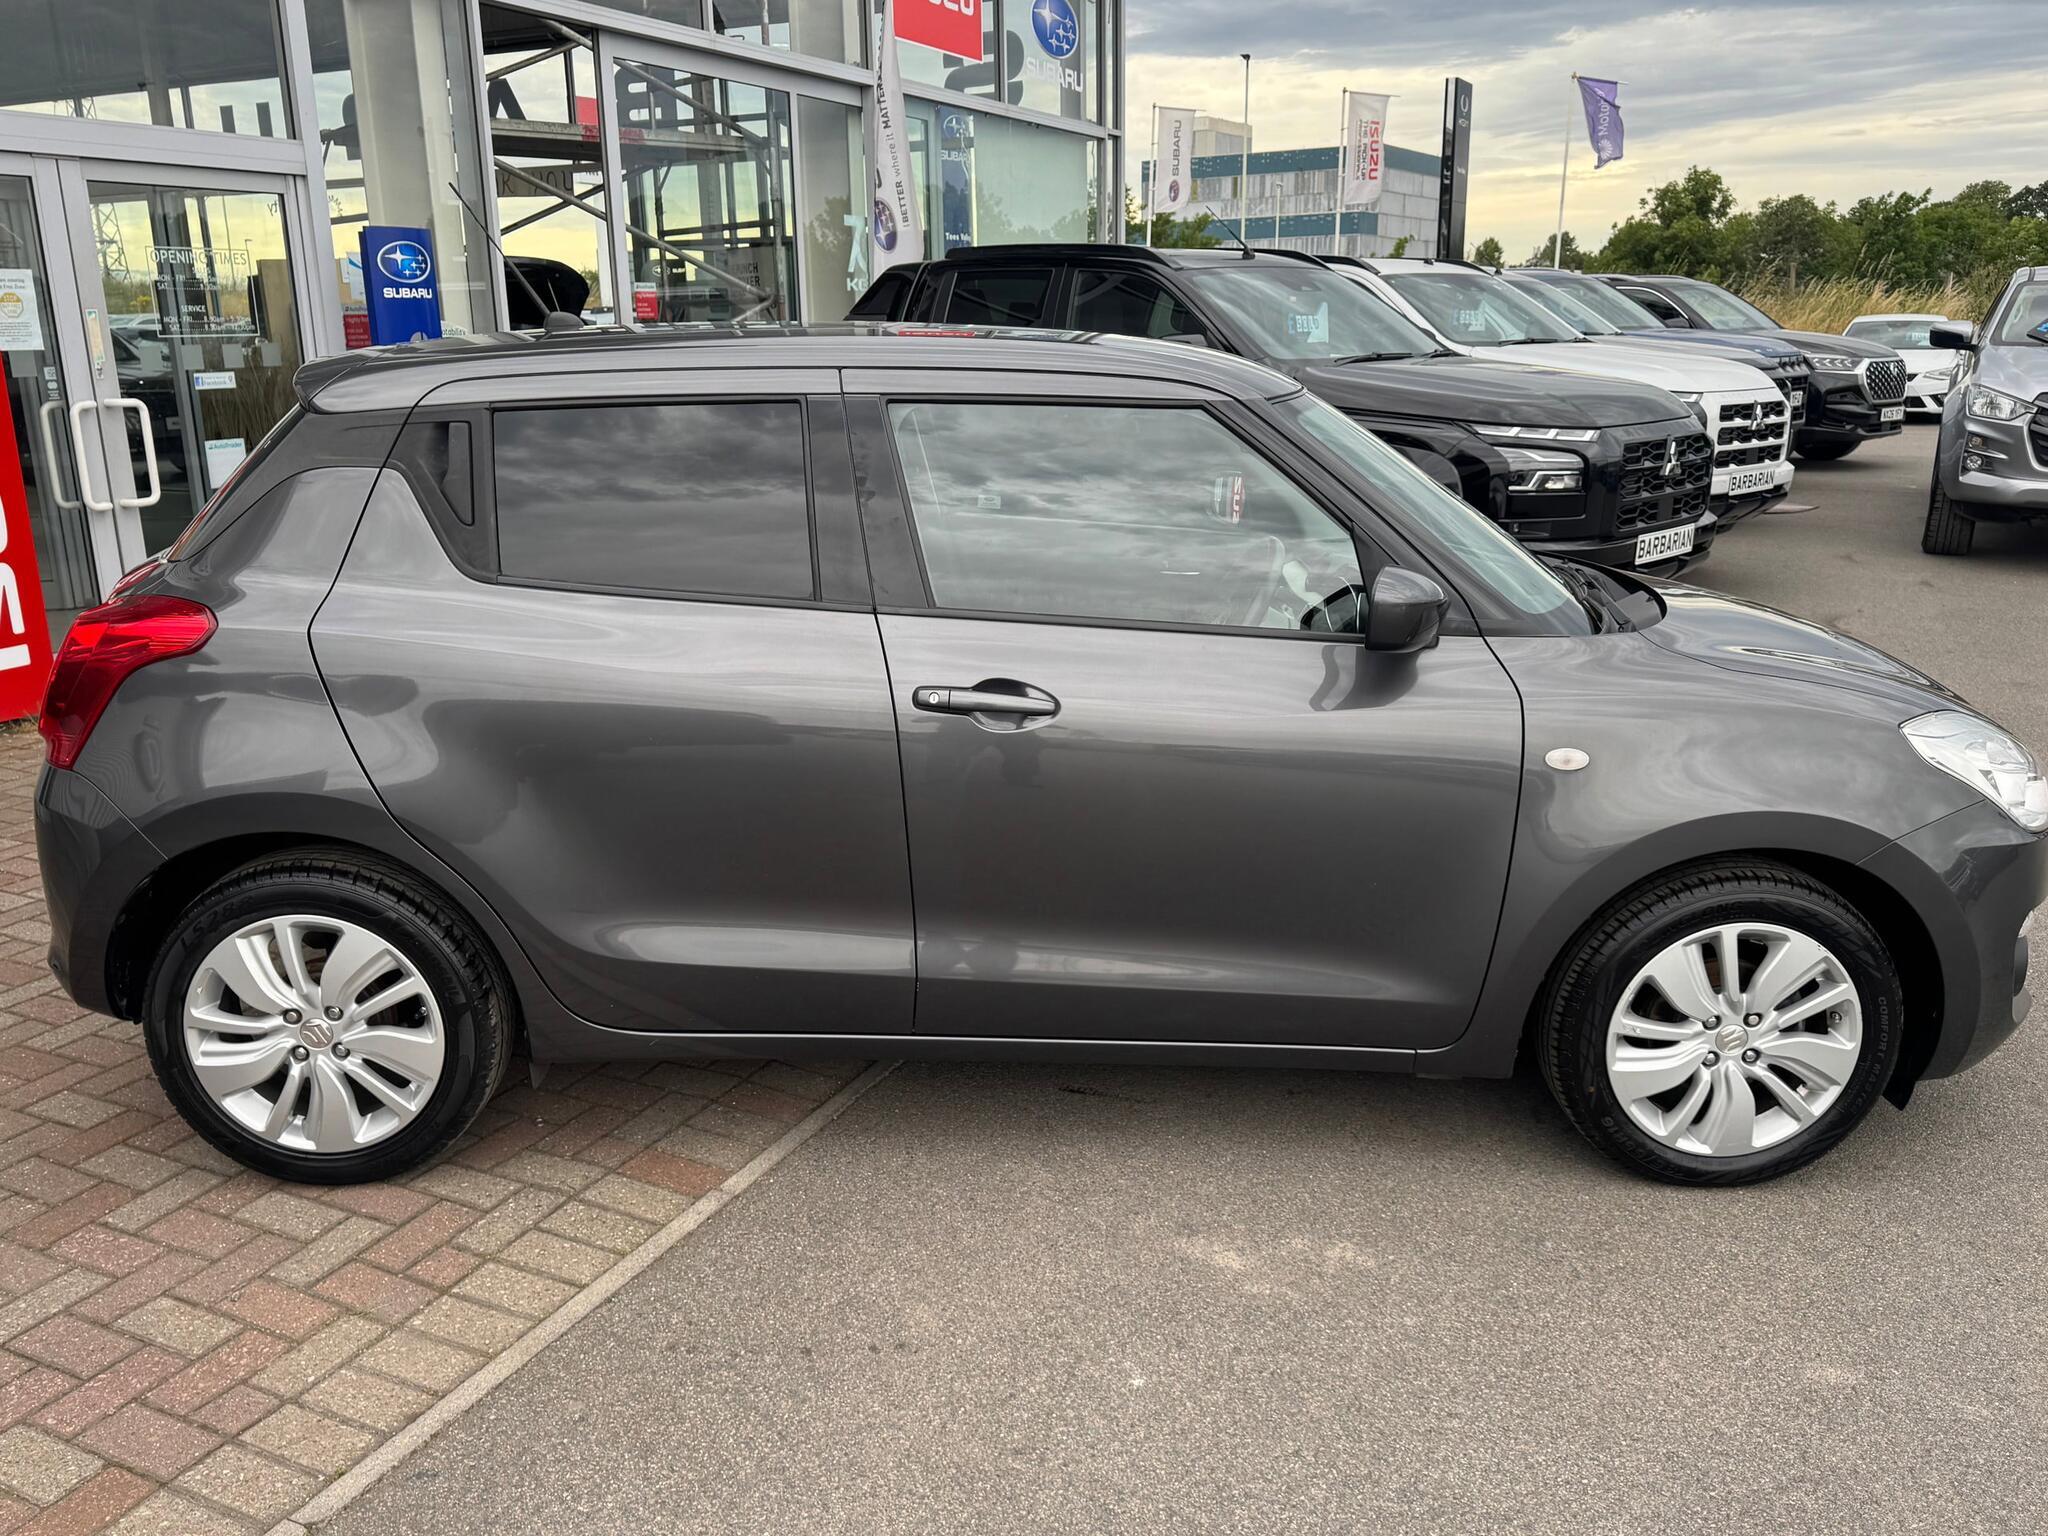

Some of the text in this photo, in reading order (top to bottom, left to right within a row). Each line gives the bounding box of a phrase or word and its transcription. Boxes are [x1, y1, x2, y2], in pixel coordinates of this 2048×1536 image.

[1025, 57, 1083, 93] SUBARU
[940, 149, 969, 162] SUBAR
[1171, 120, 1182, 177] SUBARU
[1369, 120, 1380, 180] ISUZU
[886, 132, 909, 223] BETTER where it
[150, 249, 247, 266] OPENING TIMES
[382, 287, 433, 299] SUBARU
[847, 278, 869, 291] KG
[181, 304, 206, 313] SERVICE
[1730, 470, 1774, 492] BARBARIAN
[1638, 528, 1694, 560] BARBARIAN
[1877, 995, 1889, 1060] COMFORT
